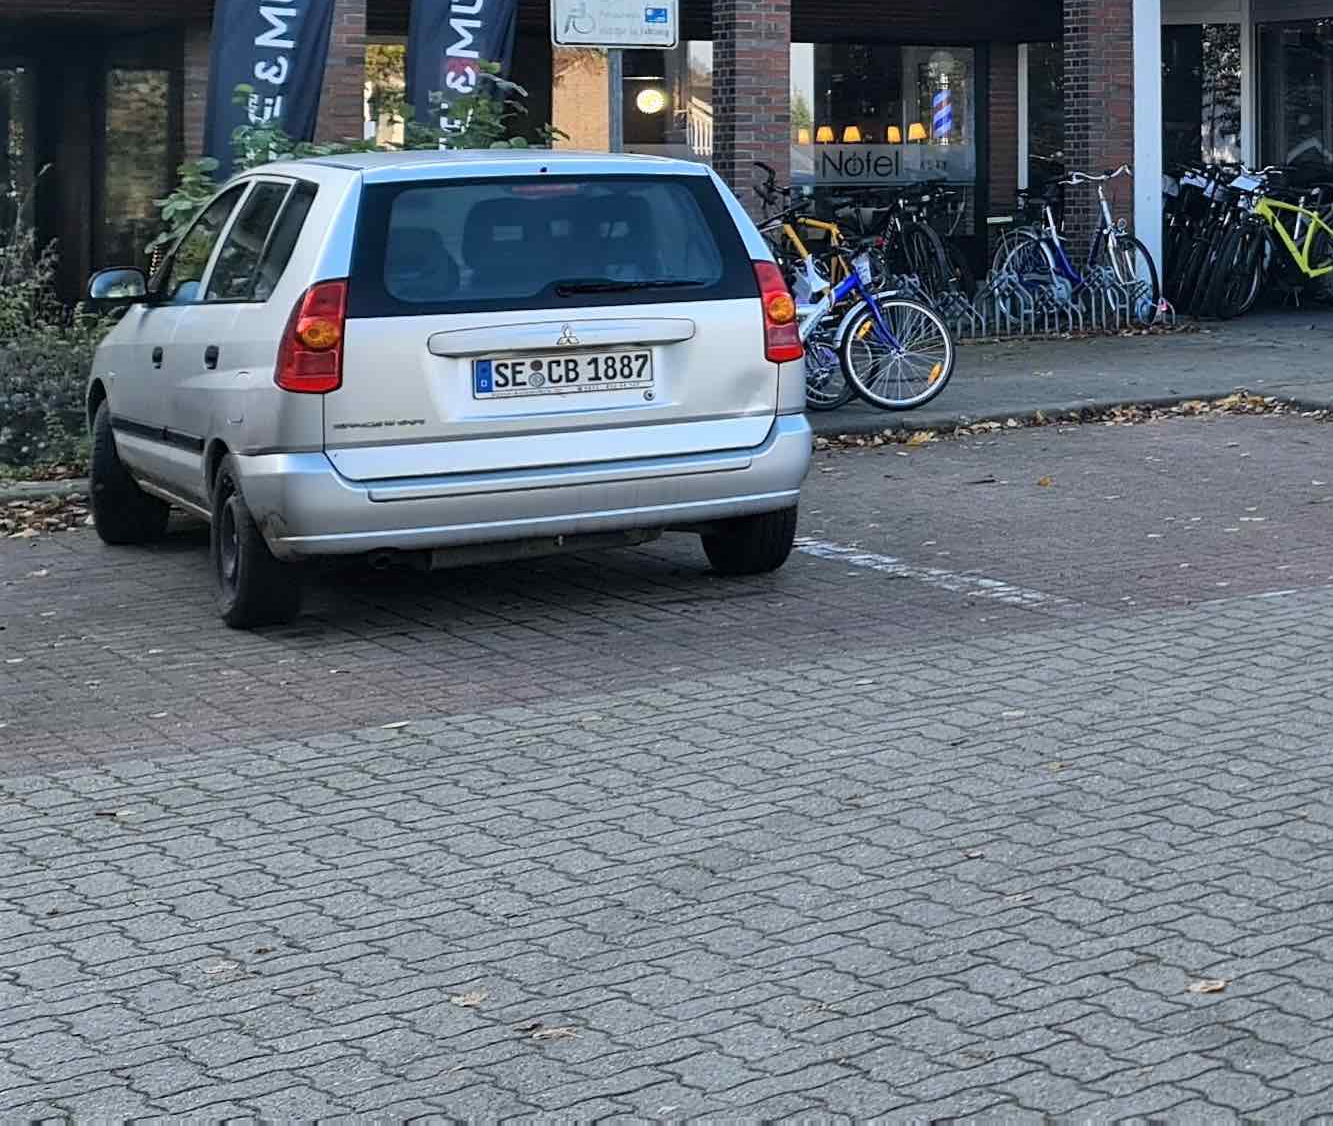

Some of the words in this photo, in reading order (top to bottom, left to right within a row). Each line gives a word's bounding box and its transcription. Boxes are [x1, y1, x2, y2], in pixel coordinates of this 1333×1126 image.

[495, 361, 527, 387] SE
[546, 357, 579, 383] CB
[587, 353, 648, 381] 1887
